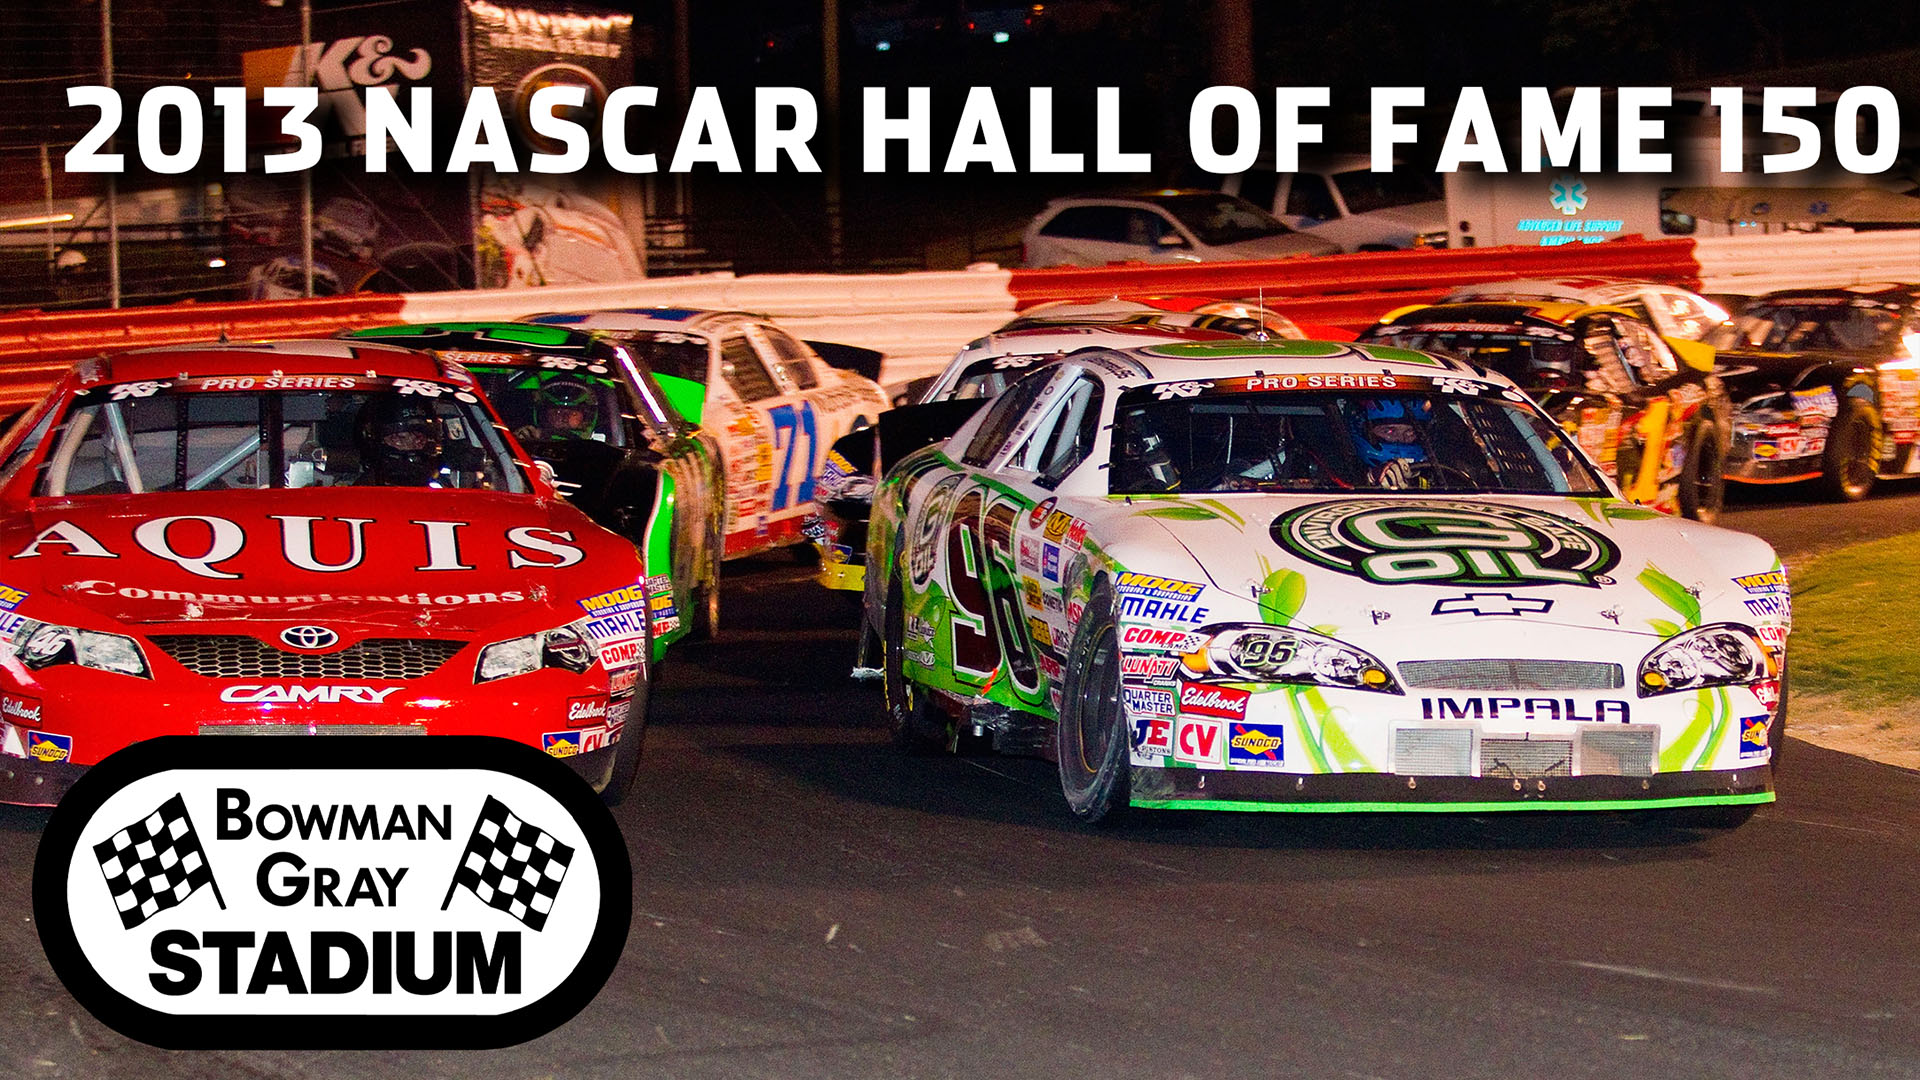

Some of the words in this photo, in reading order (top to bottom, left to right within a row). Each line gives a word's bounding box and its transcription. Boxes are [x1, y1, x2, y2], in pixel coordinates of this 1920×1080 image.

[1517, 219, 1563, 231] ADVANCED
[1563, 219, 1584, 232] LIFE
[1584, 219, 1624, 232] SUPPORT
[444, 351, 512, 363] SERIES
[201, 378, 256, 390] PRO
[263, 375, 356, 389] SERIES
[1246, 376, 1298, 391] PRO
[1307, 374, 1397, 389] SERIES
[767, 399, 817, 512] 71
[1520, 516, 1588, 552] SAFE
[9, 514, 586, 580] AQUIS
[1363, 550, 1589, 583] OIL
[75, 579, 525, 605] Communications
[945, 486, 1042, 698] 96
[1116, 572, 1206, 596] MOOG
[581, 585, 644, 611] MOOG
[1120, 596, 1210, 624] MAHLE
[585, 610, 646, 639] MAHLE
[1123, 627, 1187, 645] COMP
[27, 630, 71, 656] 46
[601, 642, 637, 665] COMP
[1241, 640, 1299, 667] 96
[1122, 657, 1176, 678] LUNATI
[219, 685, 408, 704] CAMRY
[1123, 687, 1172, 704] QUARTER
[1132, 699, 1174, 714] MASTER
[1181, 686, 1245, 714] Edelbrock
[1, 697, 42, 722] Edelbrock
[568, 700, 608, 721] Edelbrock
[1420, 697, 1631, 724] IMPALA
[1130, 719, 1171, 748] JE
[1179, 723, 1218, 757] CV
[1233, 737, 1280, 748] SUNOCO
[31, 746, 67, 759] SUNOCO
[548, 745, 578, 756] SUNOCO
